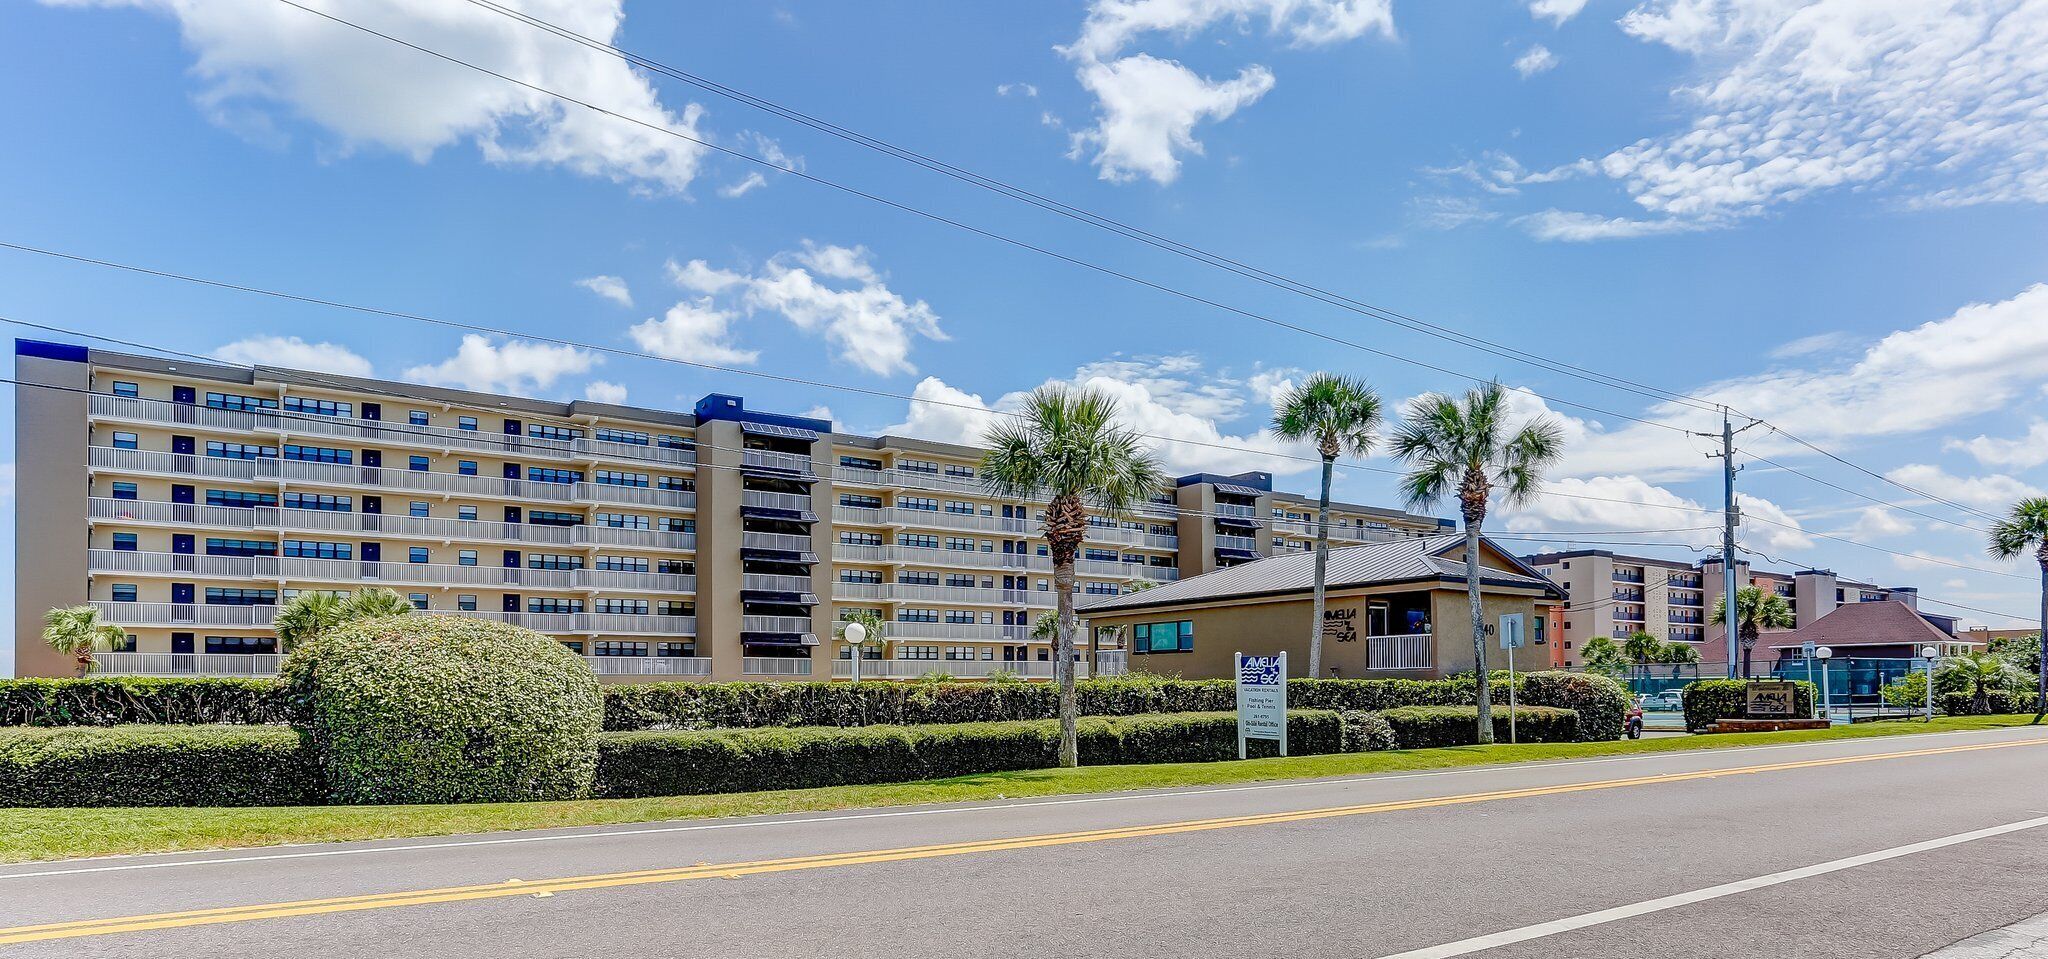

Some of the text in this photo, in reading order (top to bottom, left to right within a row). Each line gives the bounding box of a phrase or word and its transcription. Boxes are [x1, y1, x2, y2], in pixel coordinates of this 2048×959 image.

[1324, 608, 1356, 619] AMELIA
[1337, 632, 1356, 642] SEA
[1245, 657, 1280, 667] AMELIA
[1261, 674, 1280, 684] SEA
[1754, 693, 1787, 702] AMELIA
